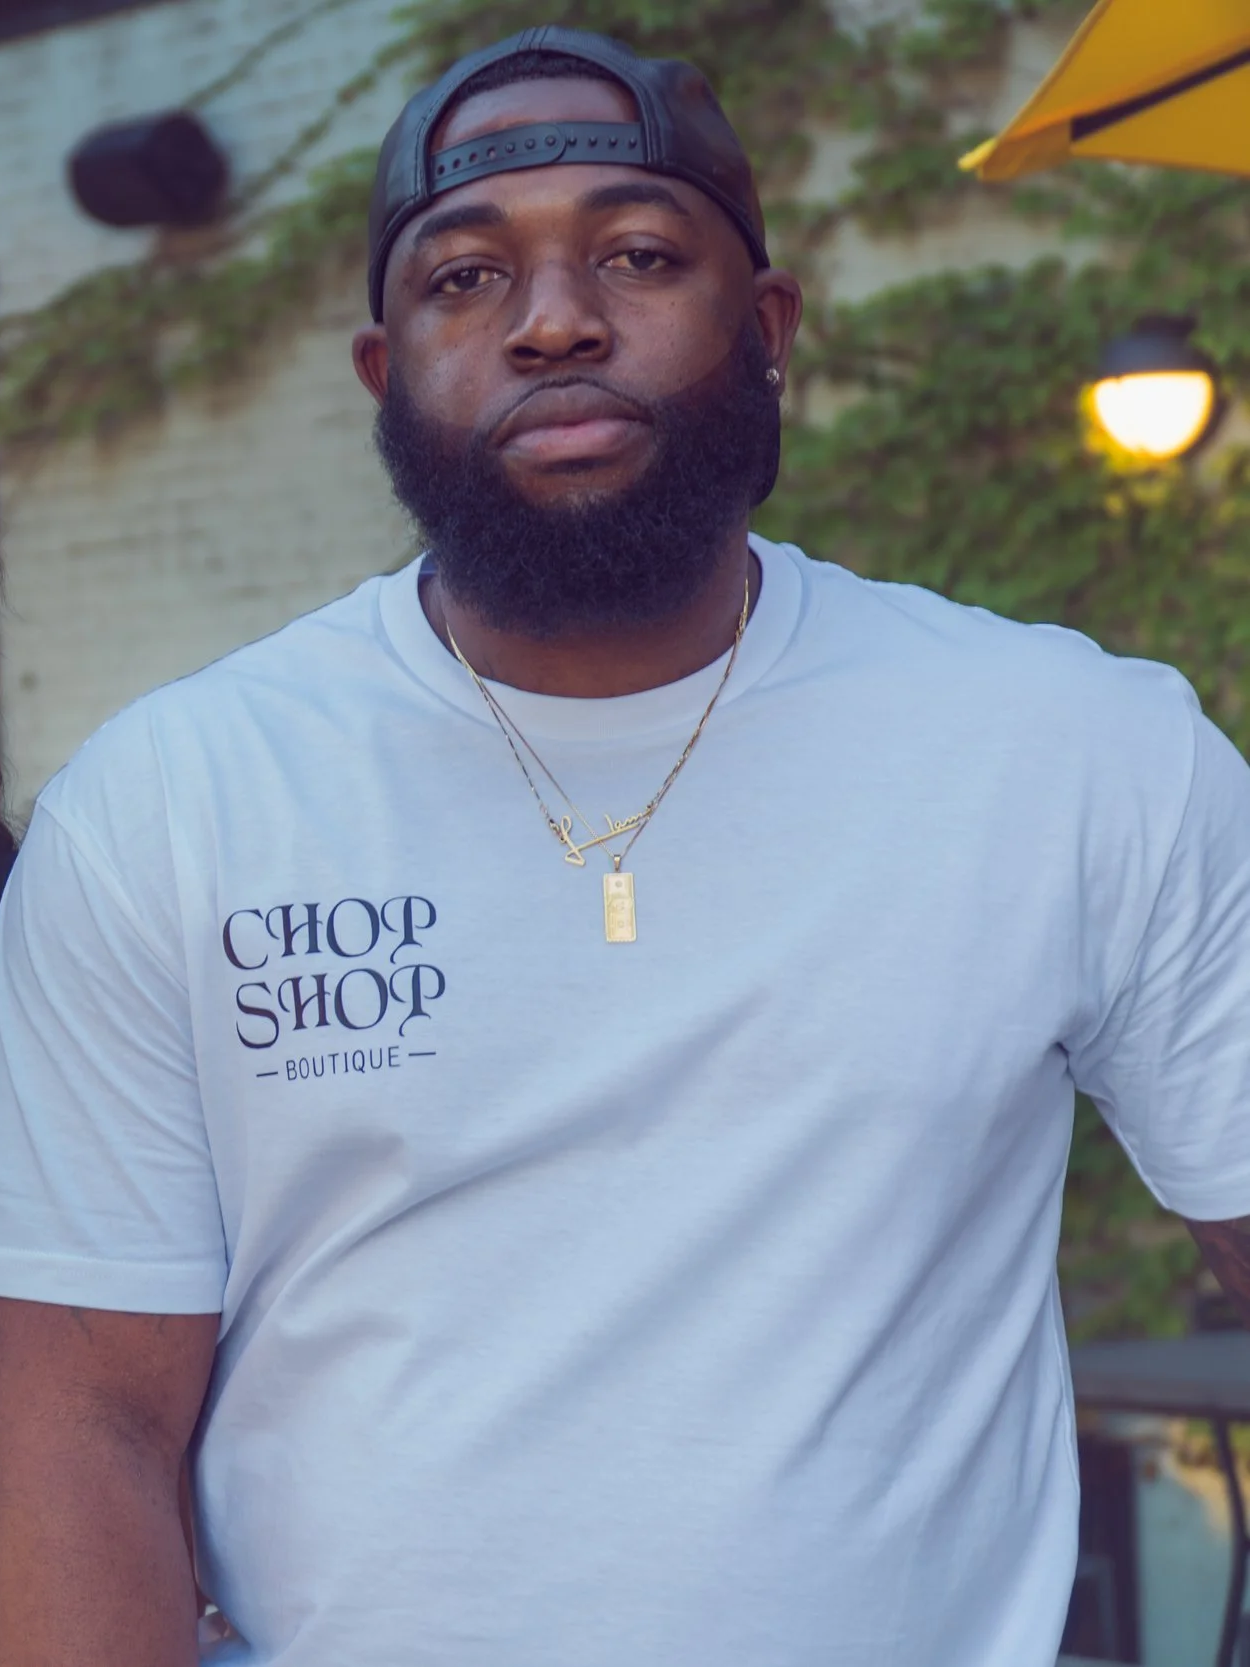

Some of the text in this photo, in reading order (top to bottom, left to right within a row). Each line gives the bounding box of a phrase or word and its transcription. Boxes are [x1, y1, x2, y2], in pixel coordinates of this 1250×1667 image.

[222, 895, 437, 970] CHOP
[236, 964, 446, 1050] SHOP
[286, 1046, 401, 1081] BOUTIQUE
